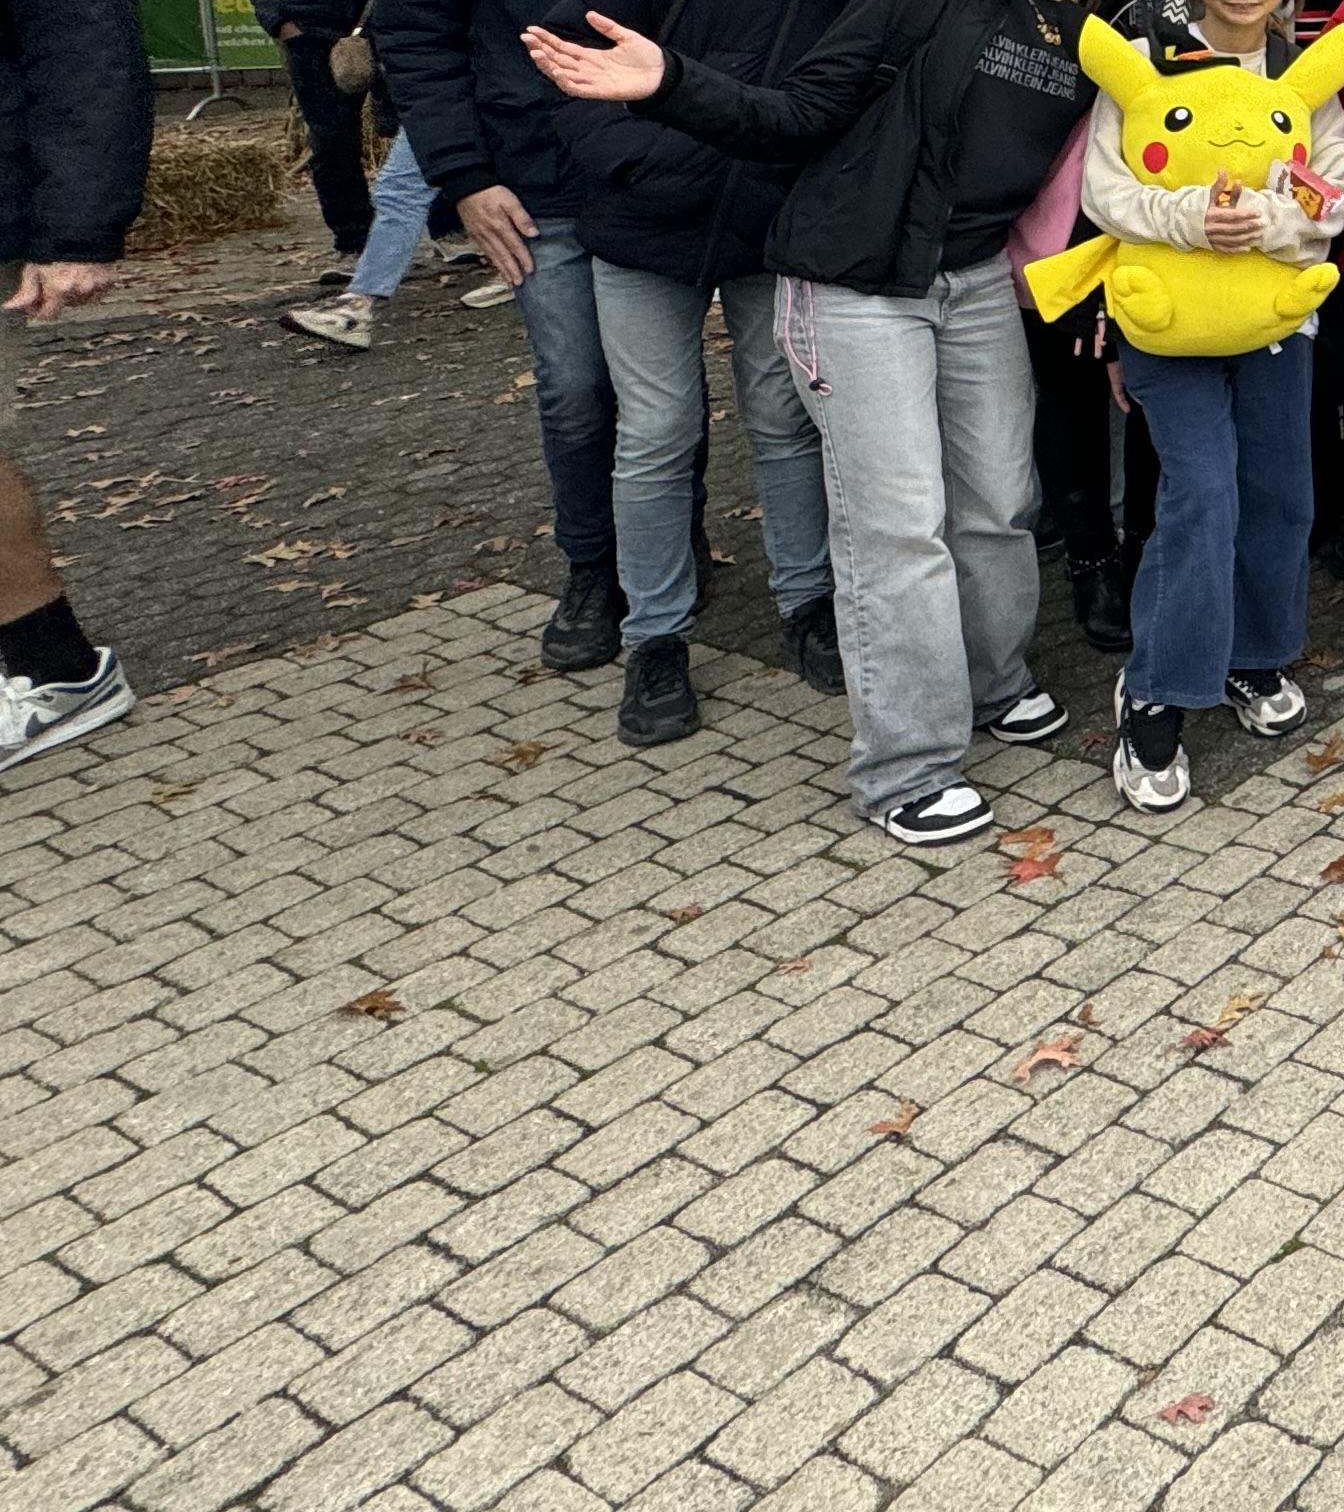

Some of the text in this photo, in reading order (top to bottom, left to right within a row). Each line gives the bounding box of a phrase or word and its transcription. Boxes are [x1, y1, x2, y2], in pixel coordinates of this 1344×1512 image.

[981, 46, 1077, 88] ALVIN KLEIN JEANS
[991, 34, 1079, 76] LVIN KLEIN JEANS
[974, 58, 1076, 101] ALVIN KLEIN JEANS
